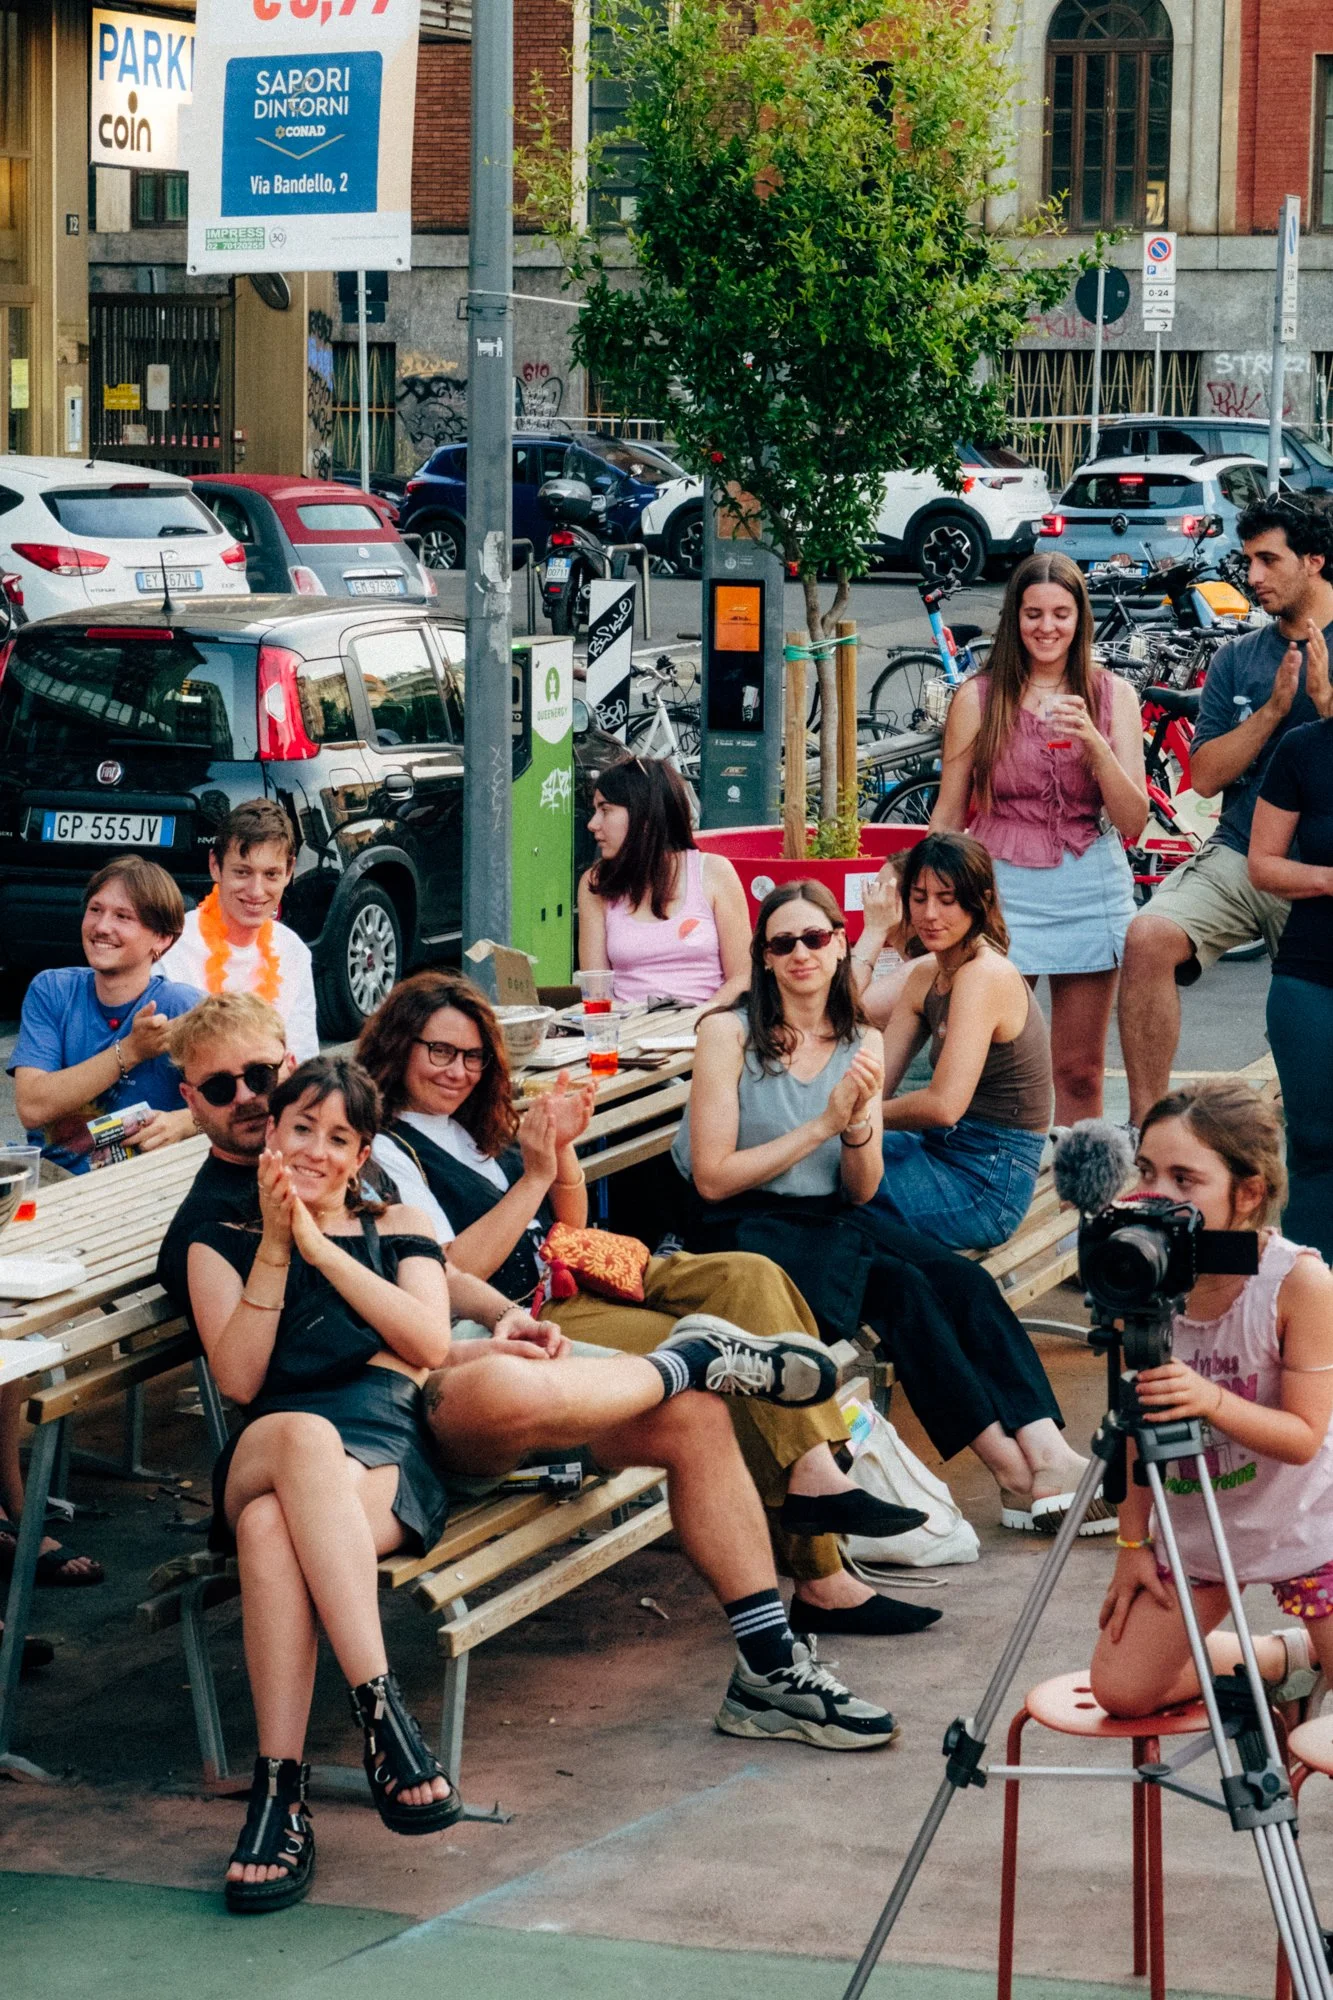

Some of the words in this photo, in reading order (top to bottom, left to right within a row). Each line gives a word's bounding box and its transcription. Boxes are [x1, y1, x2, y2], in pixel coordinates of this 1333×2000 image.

[255, 67, 350, 95] SAPORI
[254, 95, 349, 119] DINTORNI
[98, 90, 152, 152] coin
[285, 125, 326, 137] CONAD
[250, 175, 270, 195] Via
[273, 173, 336, 194] Bandello,
[339, 172, 349, 192] 2
[207, 227, 264, 239] IMPRESS
[1148, 289, 1169, 297] 0-24
[145, 573, 158, 588] EY
[101, 766, 116, 778] FIAT
[57, 814, 83, 839] GP
[90, 815, 159, 843] 555JV
